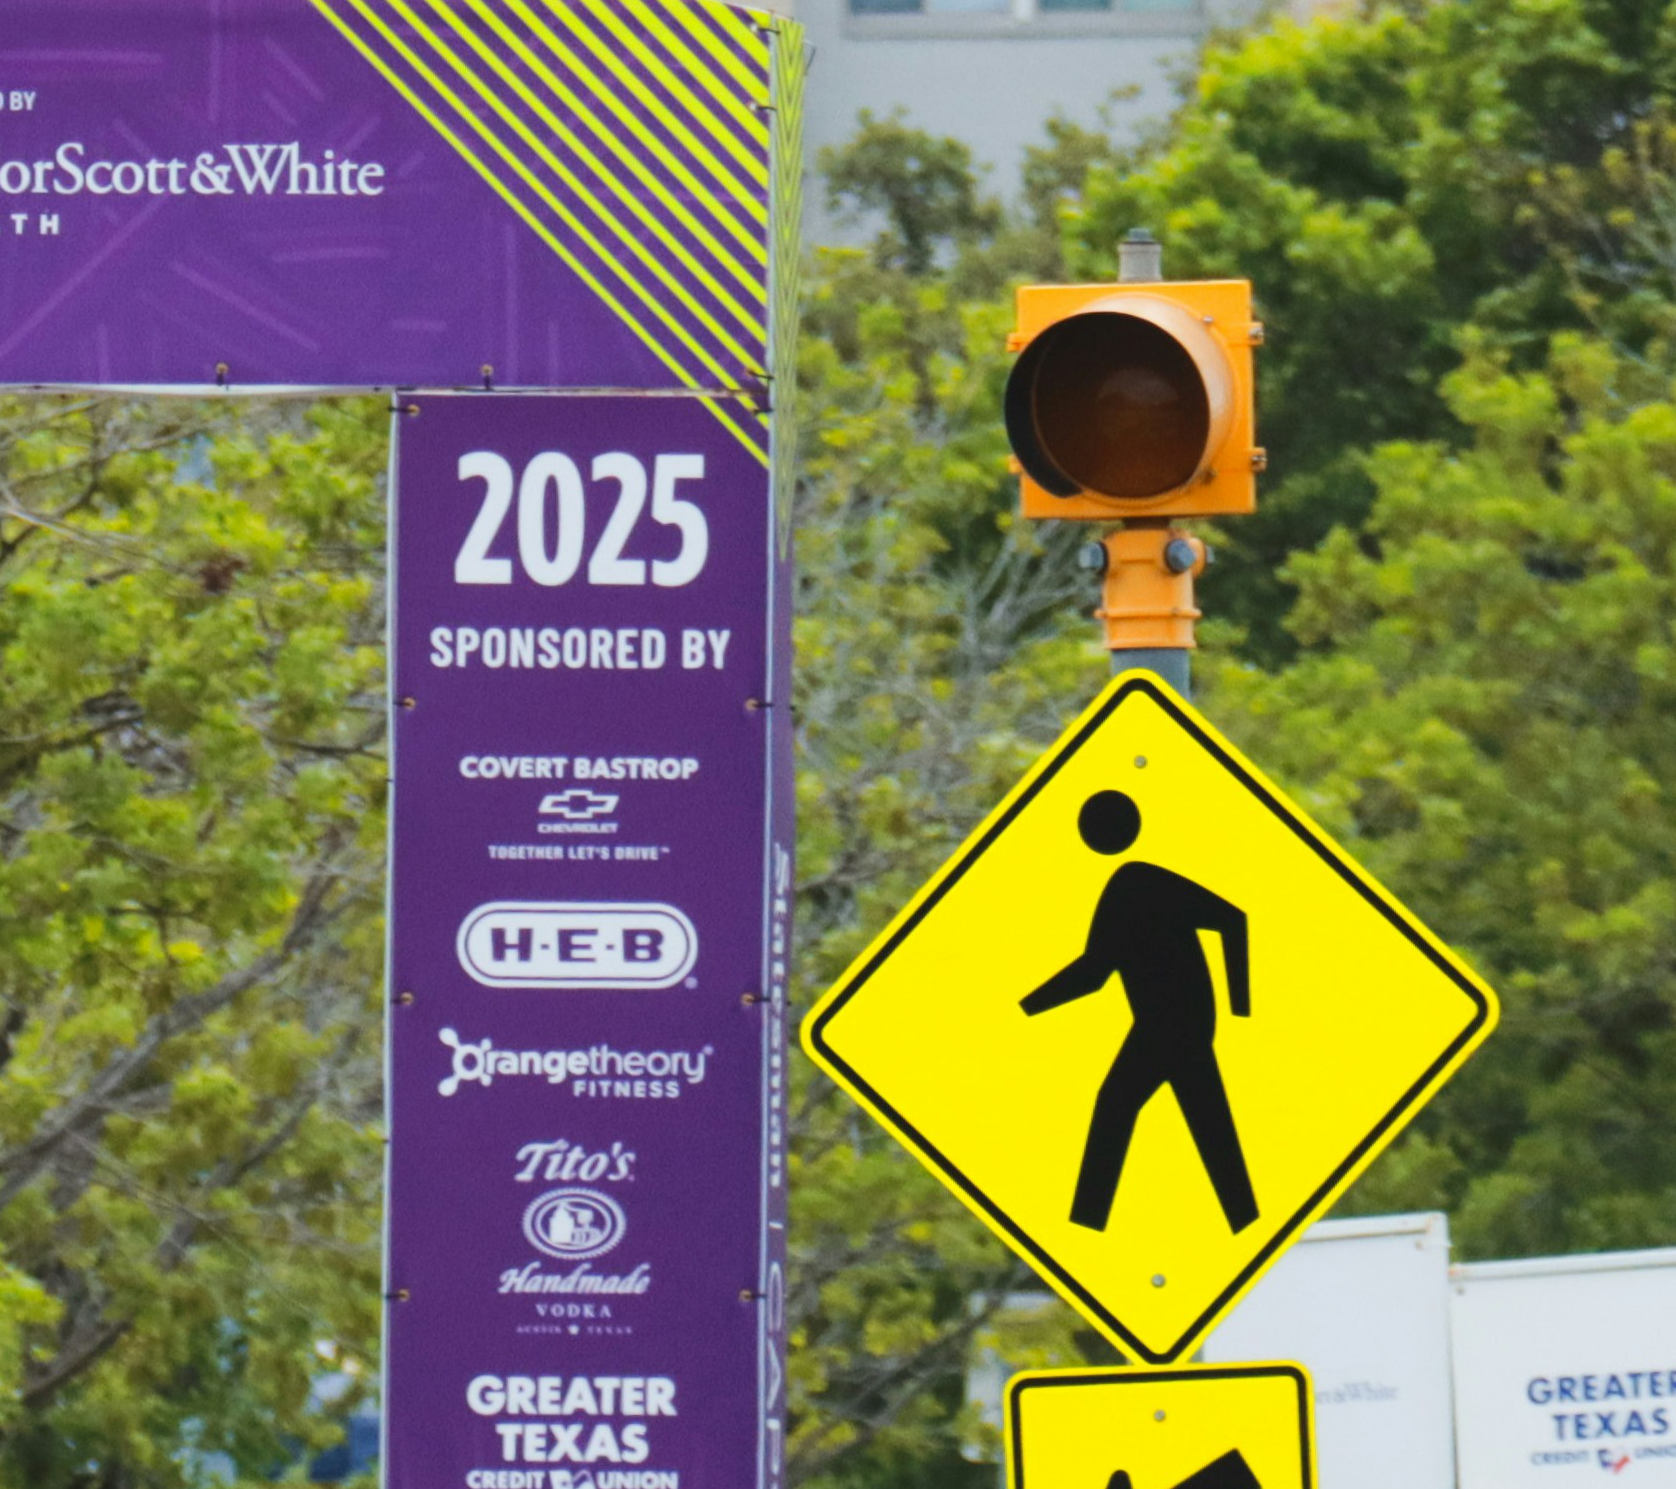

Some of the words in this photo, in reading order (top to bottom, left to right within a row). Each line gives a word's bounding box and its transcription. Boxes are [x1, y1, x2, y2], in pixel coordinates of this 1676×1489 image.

[9, 90, 36, 111] BY
[454, 451, 709, 587] 2025
[430, 627, 666, 669] SPONSORED
[682, 629, 731, 669] BY
[459, 756, 568, 779] COVERT
[574, 757, 699, 780] BASTROP
[488, 846, 563, 860] TOGETHER
[568, 846, 610, 860] LET'S
[573, 1081, 680, 1099] FITNESS
[515, 1140, 636, 1182] Tito's
[498, 1262, 651, 1294] Handmade
[536, 1304, 612, 1318] VODKA
[466, 1375, 677, 1415] GREATER
[1552, 1408, 1669, 1440] TEXAS
[496, 1423, 650, 1463] TEXAS
[466, 1470, 545, 1489] CREDIT
